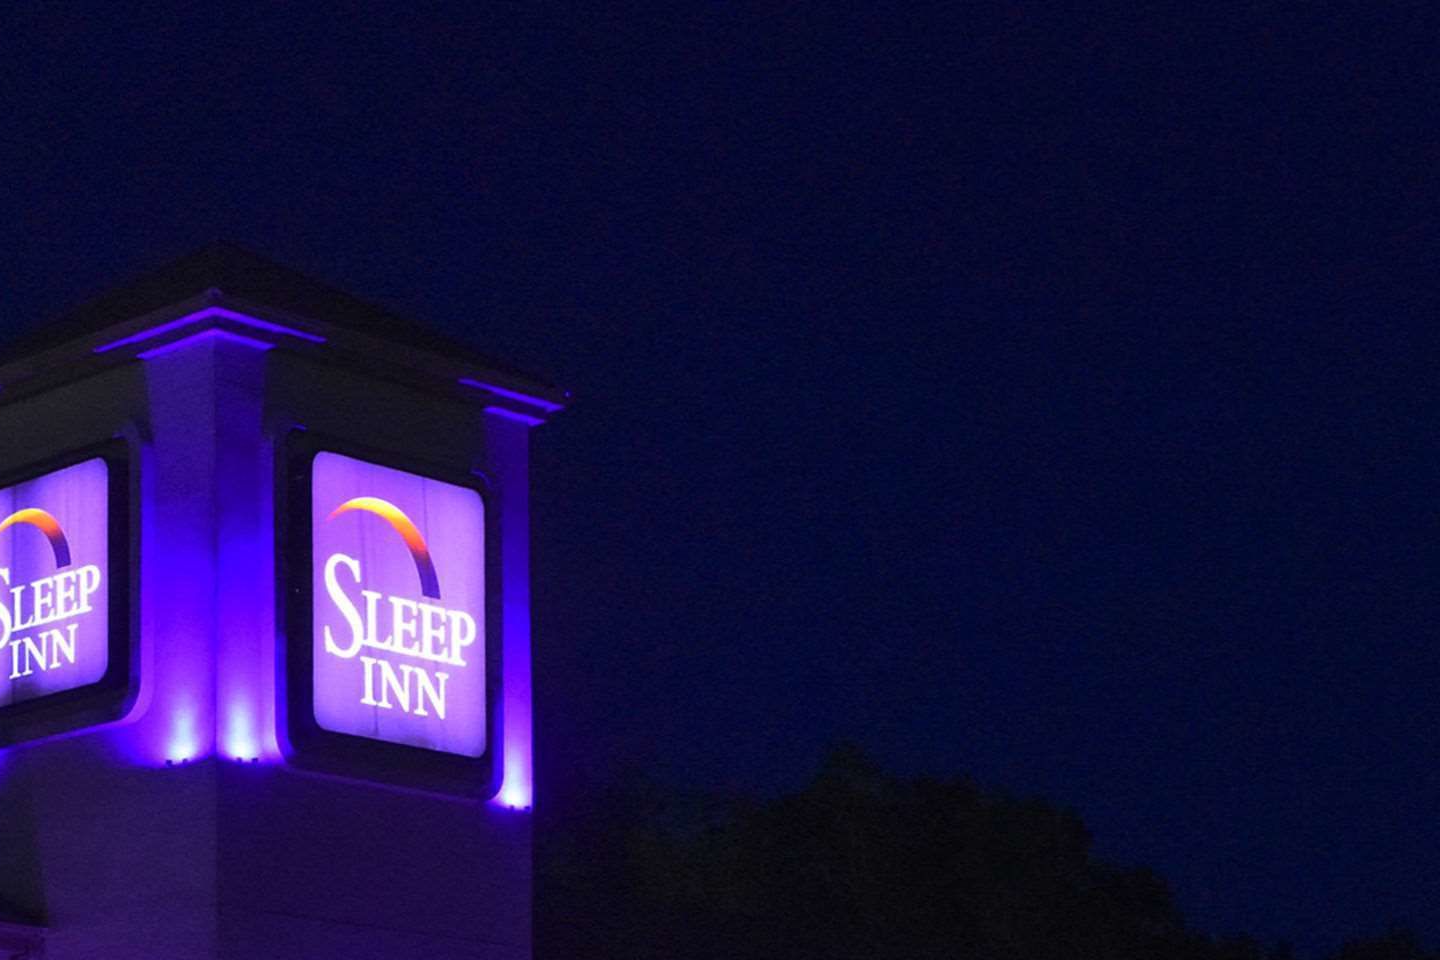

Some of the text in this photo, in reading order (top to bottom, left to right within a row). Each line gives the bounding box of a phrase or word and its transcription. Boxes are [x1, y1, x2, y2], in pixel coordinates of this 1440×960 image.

[324, 553, 476, 666] SLEEP
[9, 624, 78, 679] INN
[360, 656, 449, 720] INN
